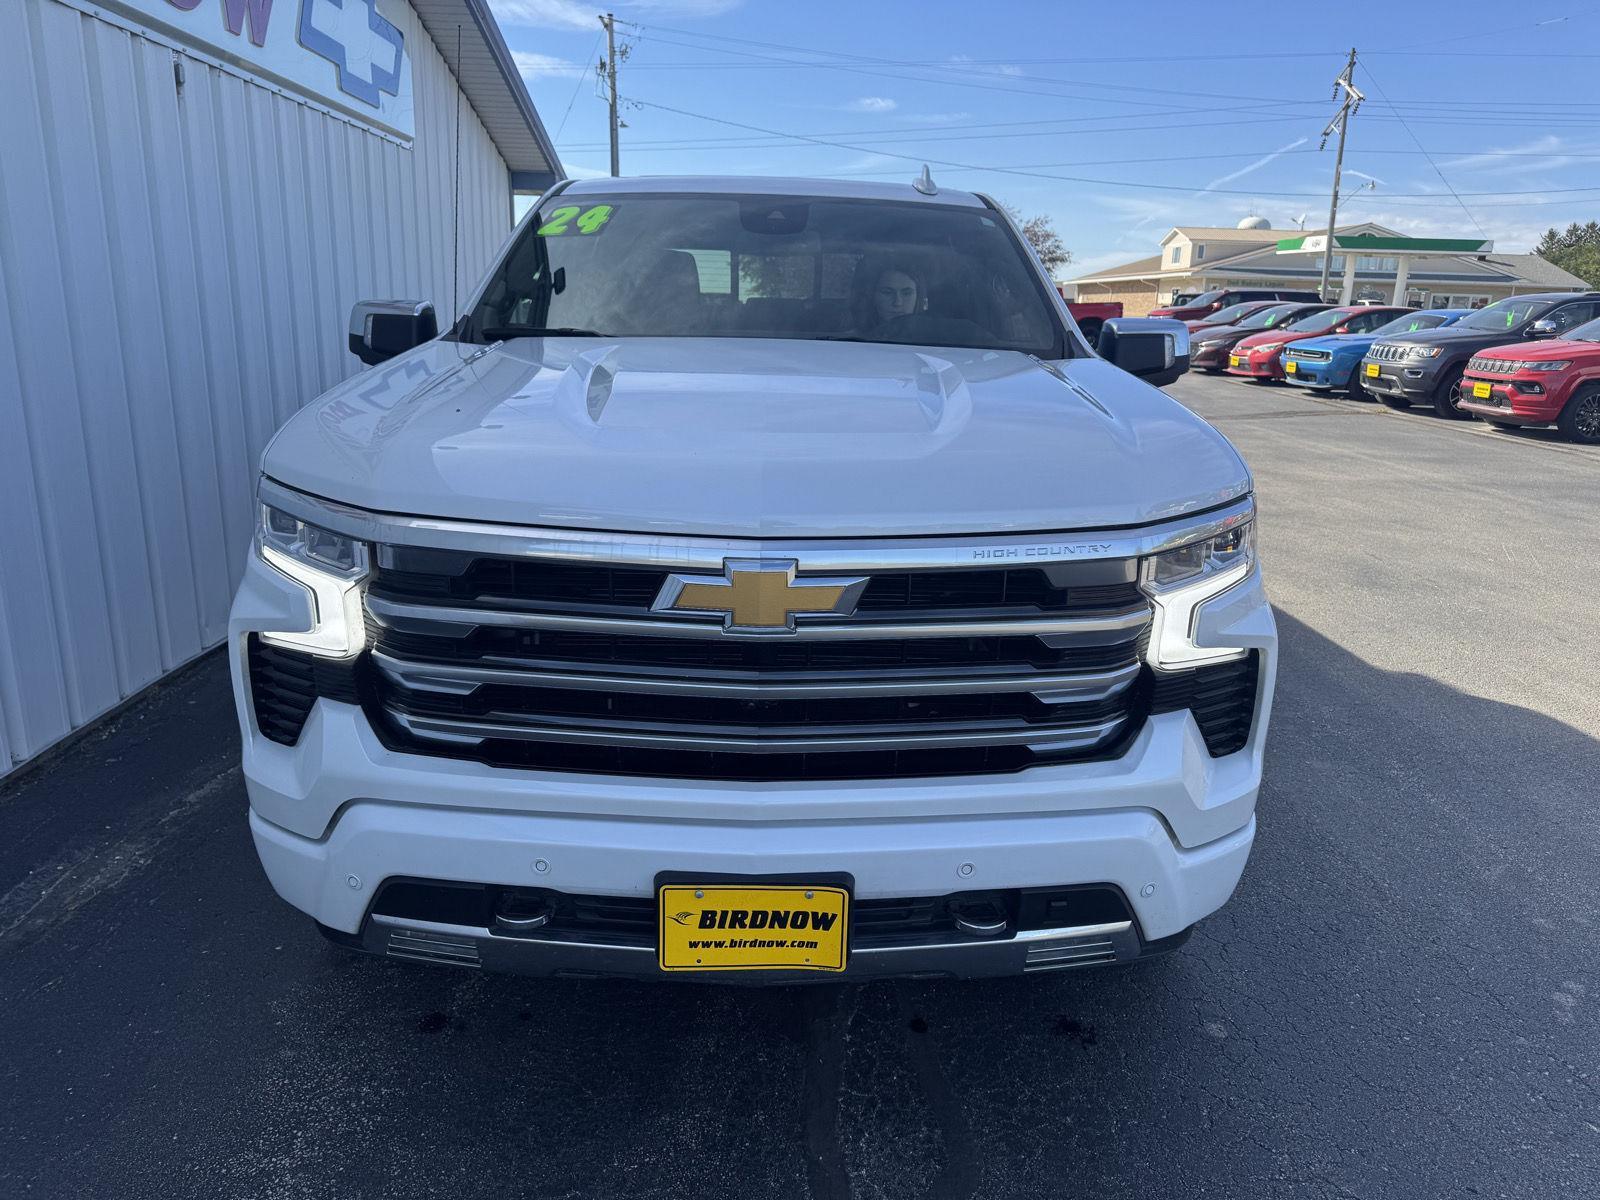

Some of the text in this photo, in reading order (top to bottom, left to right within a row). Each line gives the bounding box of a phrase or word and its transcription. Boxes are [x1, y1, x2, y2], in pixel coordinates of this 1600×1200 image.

[537, 205, 614, 236] 24
[973, 544, 1112, 559] HIGH COUNTRY
[698, 910, 838, 931] BIRDNOW
[688, 939, 818, 949] www.birdnow.com
